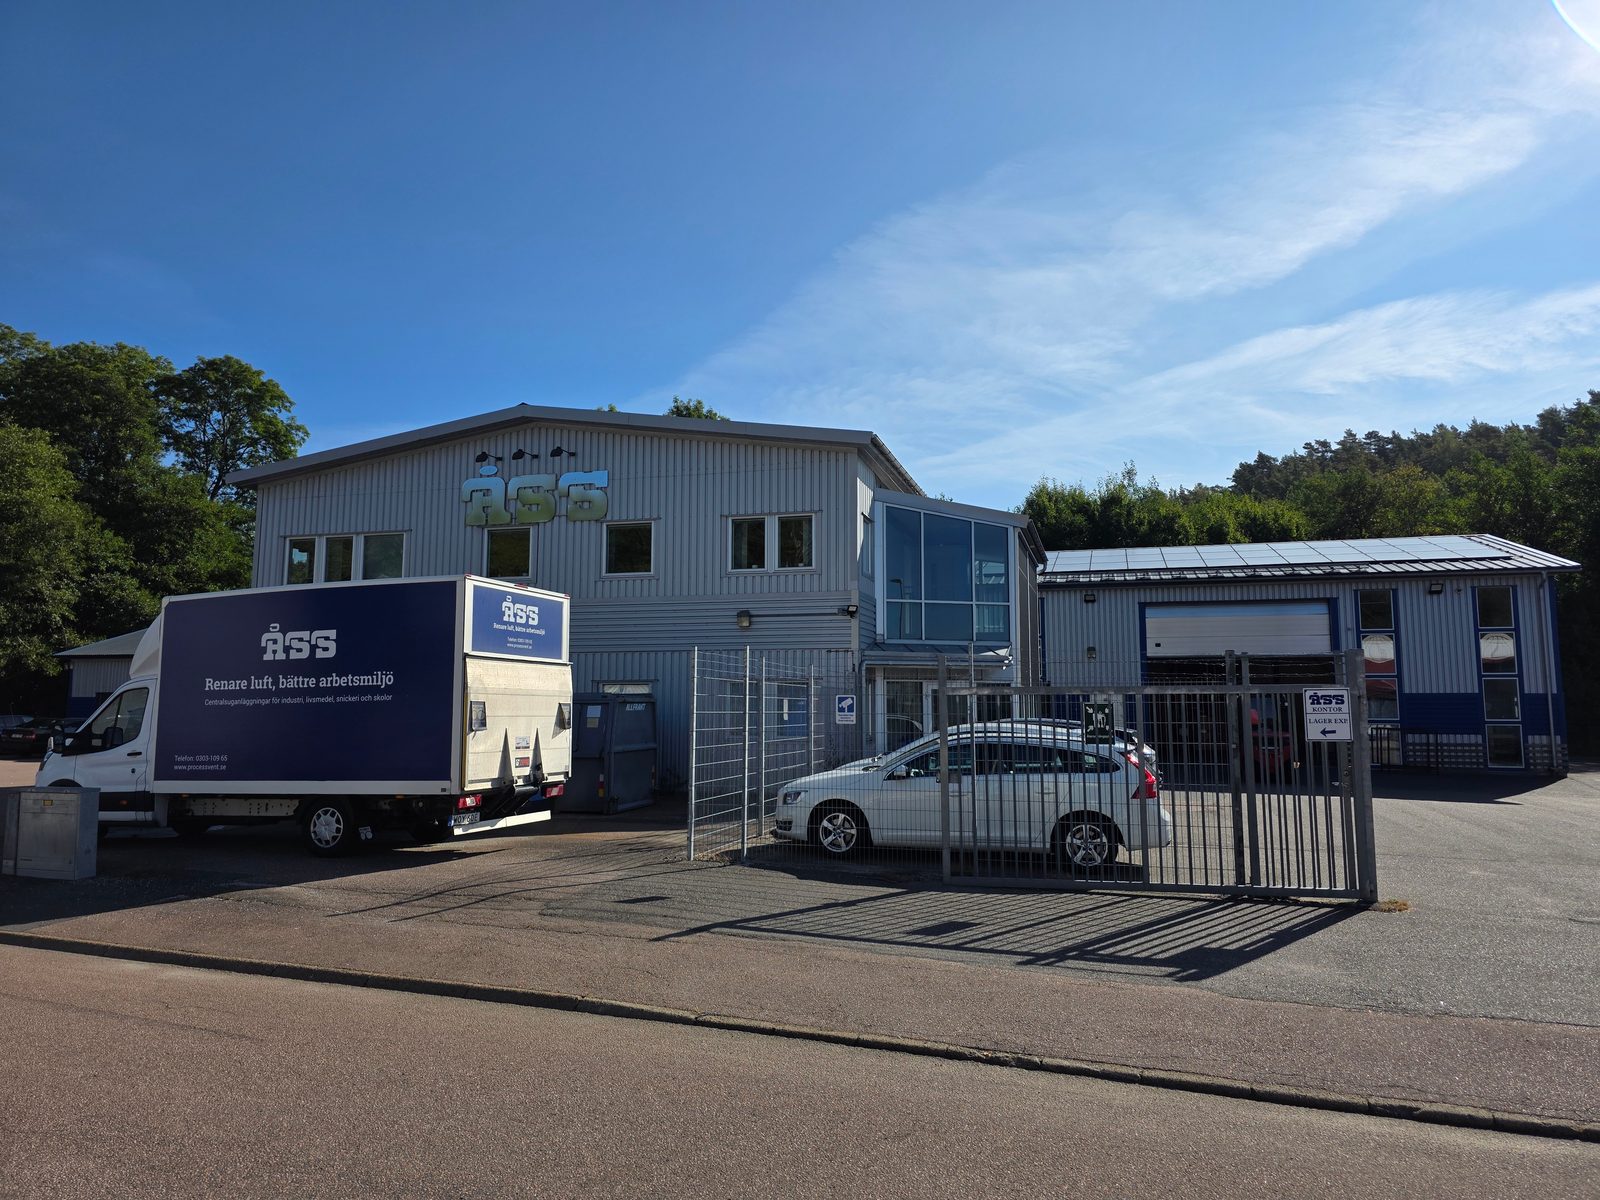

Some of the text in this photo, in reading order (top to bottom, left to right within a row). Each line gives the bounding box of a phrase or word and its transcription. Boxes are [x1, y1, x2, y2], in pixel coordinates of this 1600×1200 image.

[462, 465, 608, 526] ÅSS
[502, 595, 538, 625] ÅSS
[260, 623, 337, 661] ÅSS
[204, 670, 394, 692] Renare luft, bättre arbetsmiljö
[204, 692, 393, 707] Centralsuganläggningar för industri, livsmedel, snickeri och skolor
[1309, 692, 1345, 705] ÅSS
[174, 754, 228, 762] Telefon: 0303-109 65
